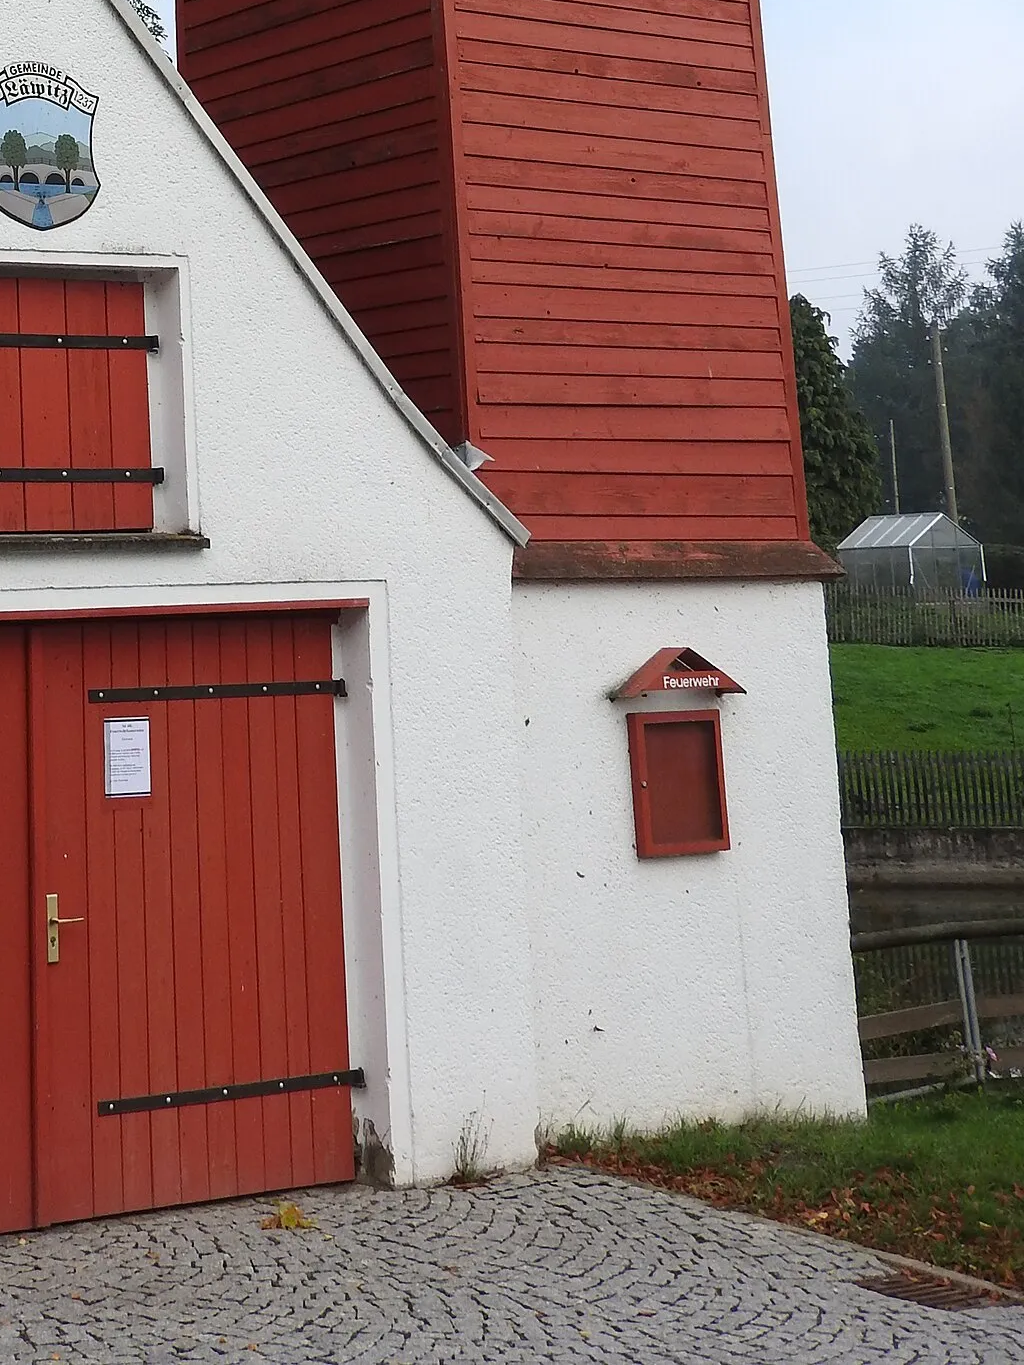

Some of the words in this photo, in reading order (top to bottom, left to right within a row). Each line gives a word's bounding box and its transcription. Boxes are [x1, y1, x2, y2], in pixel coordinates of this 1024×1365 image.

[10, 63, 63, 80] GEMEINDE
[4, 79, 69, 105] Läwitz
[74, 91, 94, 110] 1237
[663, 675, 719, 689] Feuerwehr
